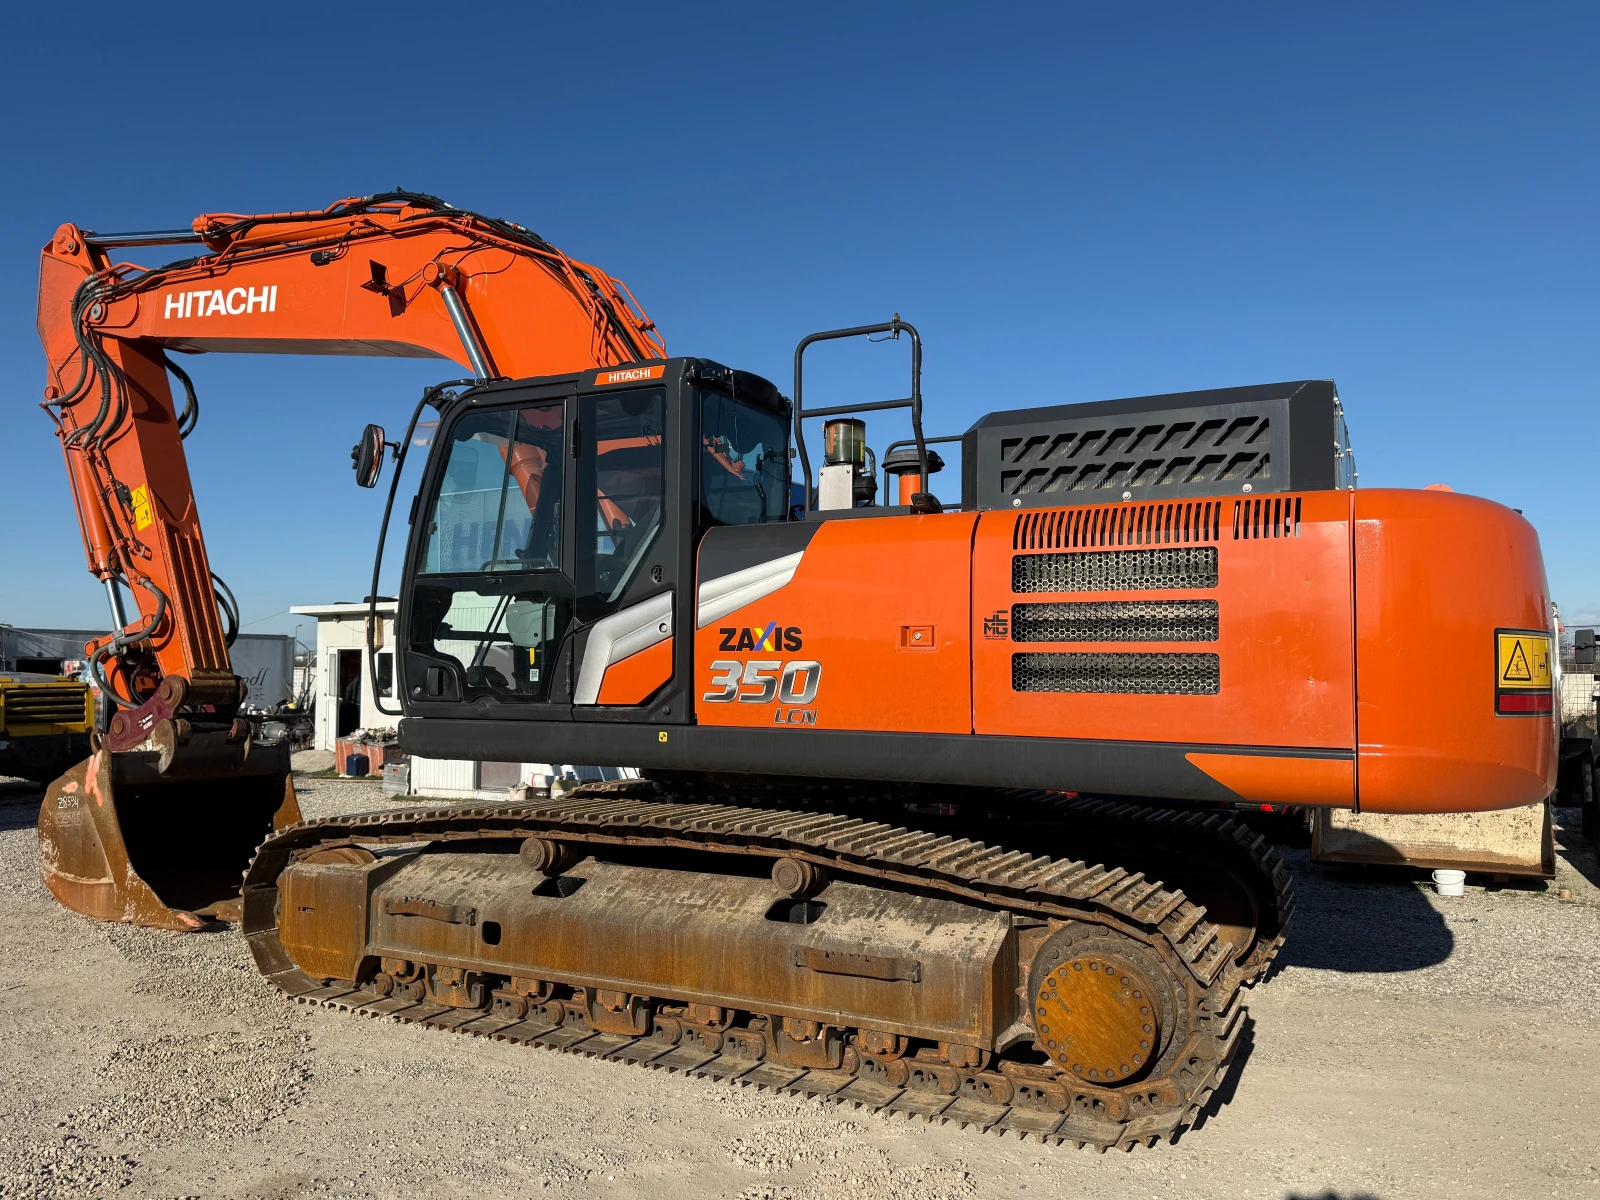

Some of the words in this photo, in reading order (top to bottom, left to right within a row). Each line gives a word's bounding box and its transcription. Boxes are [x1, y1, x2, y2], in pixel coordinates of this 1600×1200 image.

[164, 285, 278, 319] HITACHI
[608, 368, 651, 382] HITACHI
[718, 621, 803, 652] ZAXIS
[702, 660, 822, 705] 350
[773, 707, 818, 725] LCN
